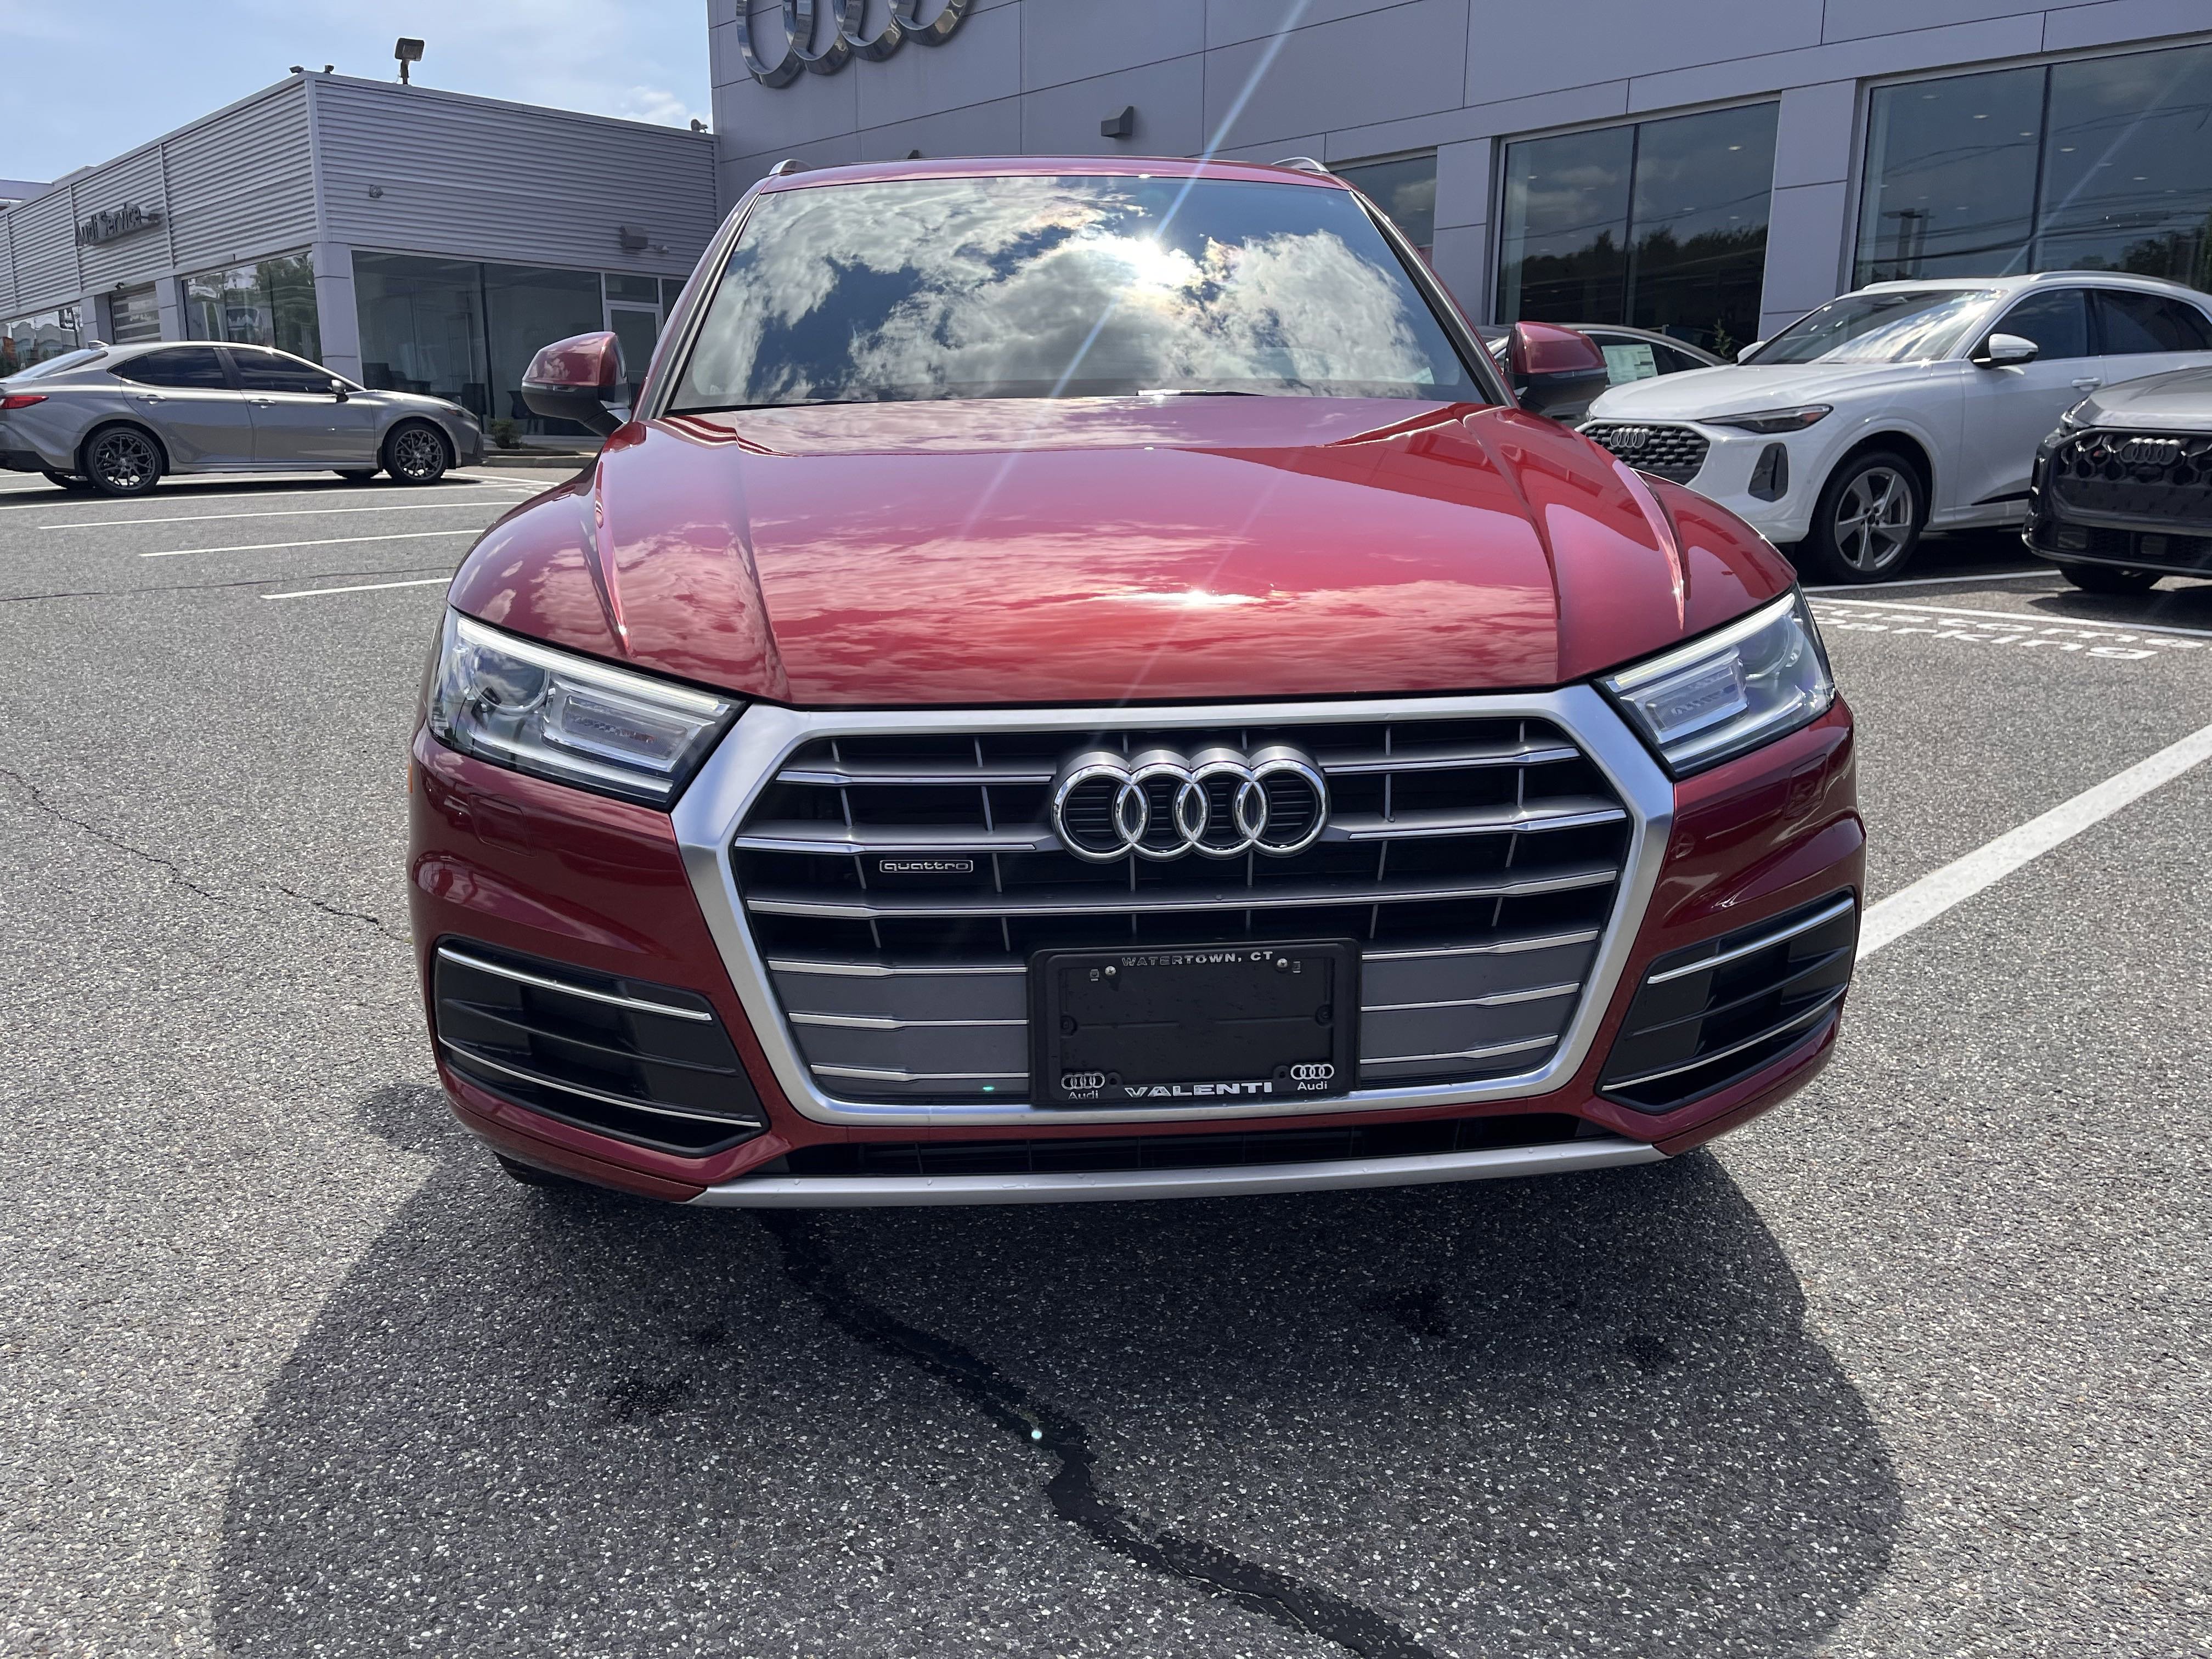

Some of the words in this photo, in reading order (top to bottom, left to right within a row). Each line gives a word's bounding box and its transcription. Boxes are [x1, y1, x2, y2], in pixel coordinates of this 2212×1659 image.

[1809, 605, 2212, 651] ustome
[884, 861, 969, 871] quattro
[1121, 953, 1242, 967] WATERTOWN,
[1250, 951, 1273, 961] CT
[1124, 1081, 1272, 1098] VALENTI
[1296, 1080, 1328, 1091] Audi
[1068, 1090, 1099, 1100] Audi
